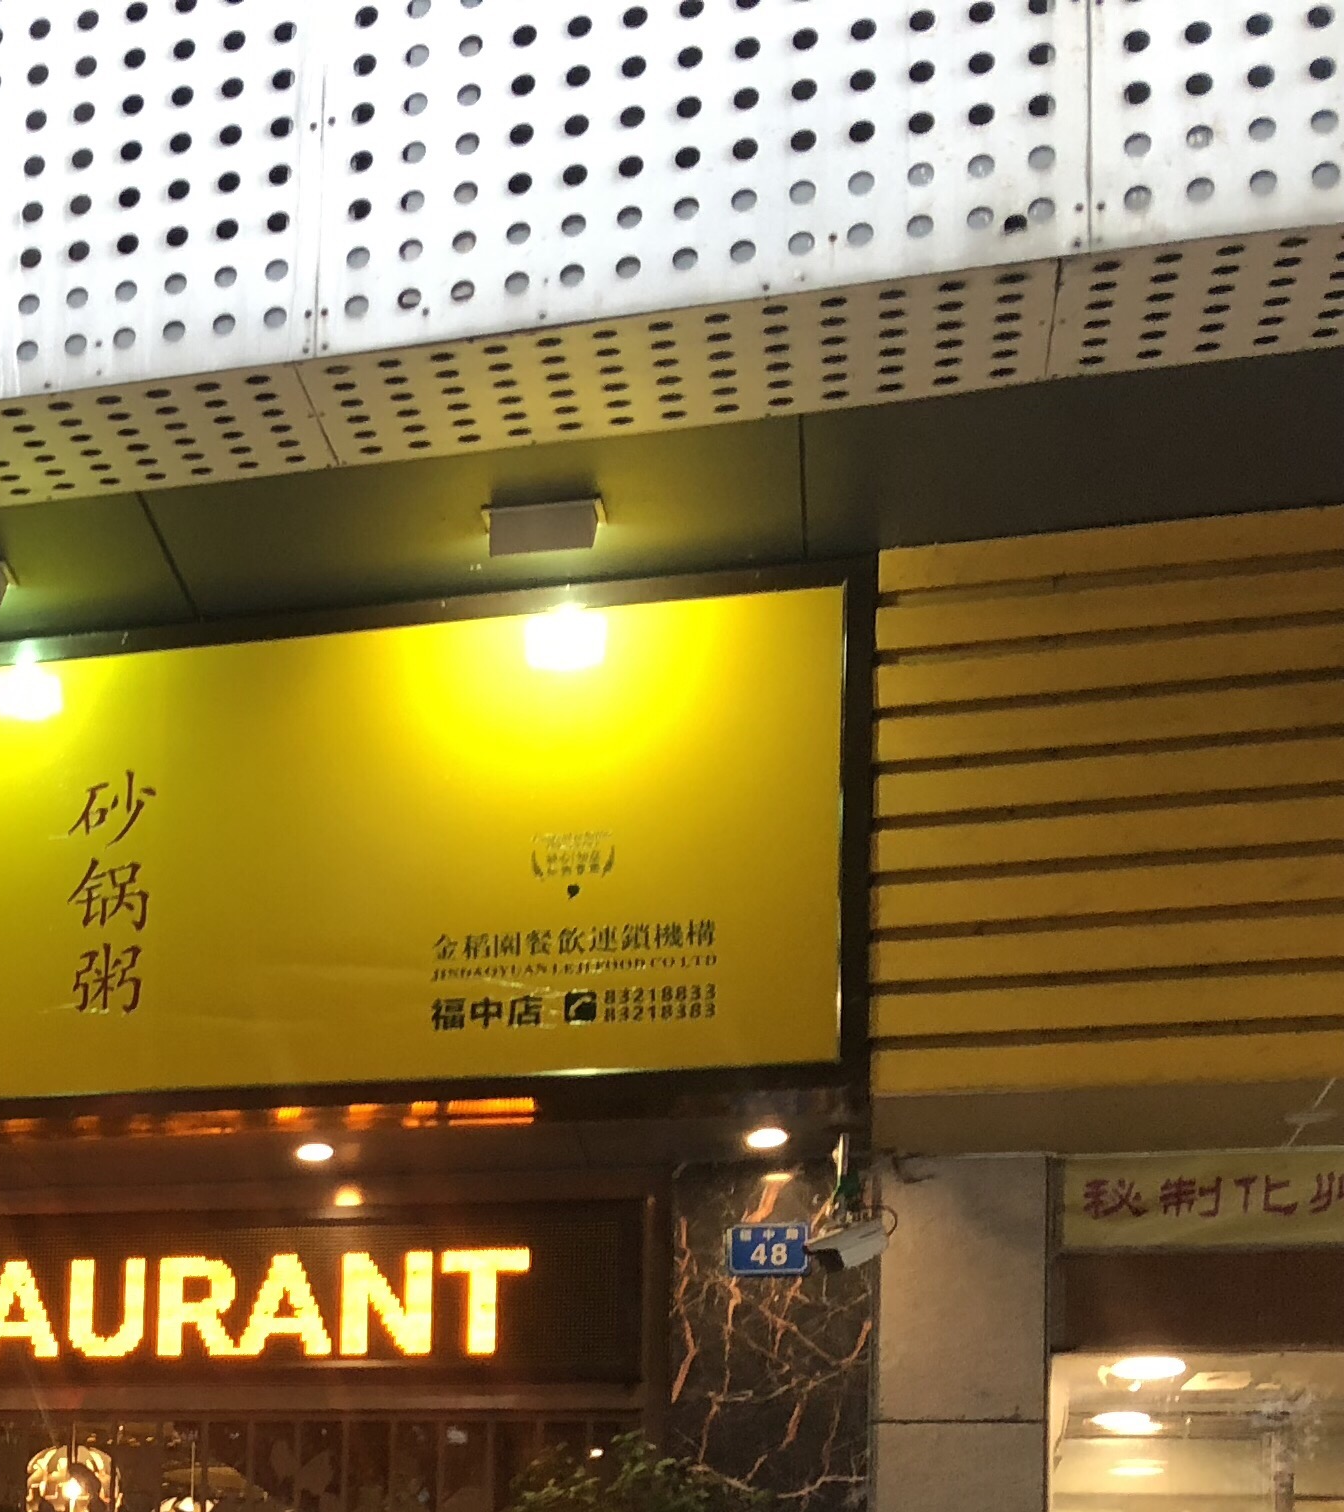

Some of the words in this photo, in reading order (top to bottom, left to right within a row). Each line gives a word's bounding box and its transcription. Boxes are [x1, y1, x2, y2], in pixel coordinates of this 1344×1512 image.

[67, 769, 157, 1014] 砂锅粥
[431, 994, 543, 1031] 福中店
[750, 1243, 789, 1267] 48
